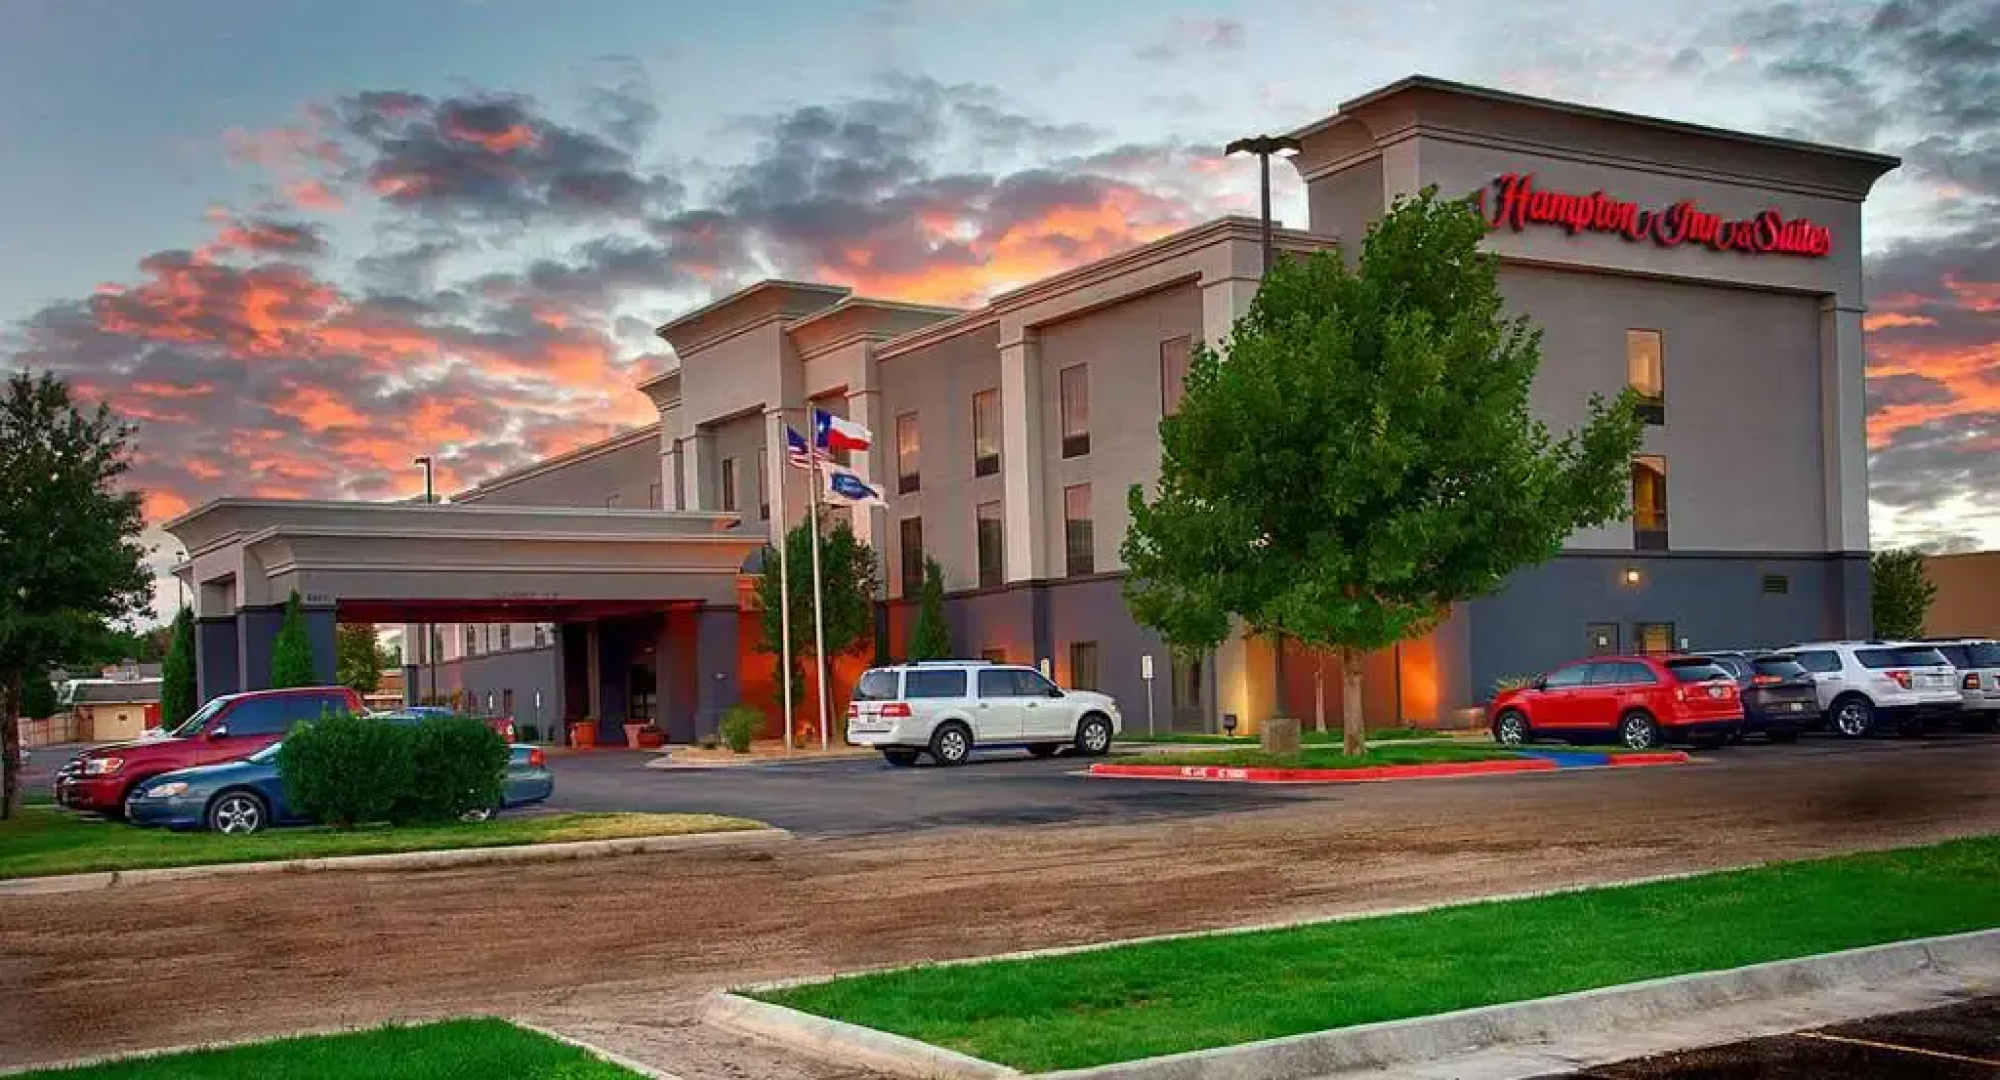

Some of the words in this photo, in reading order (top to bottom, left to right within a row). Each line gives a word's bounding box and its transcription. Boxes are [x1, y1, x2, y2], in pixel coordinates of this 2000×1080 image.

[1481, 172, 1653, 240] Hampton
[1655, 200, 1735, 249] Inn
[1736, 220, 1753, 248] &
[1755, 205, 1831, 256] Suites
